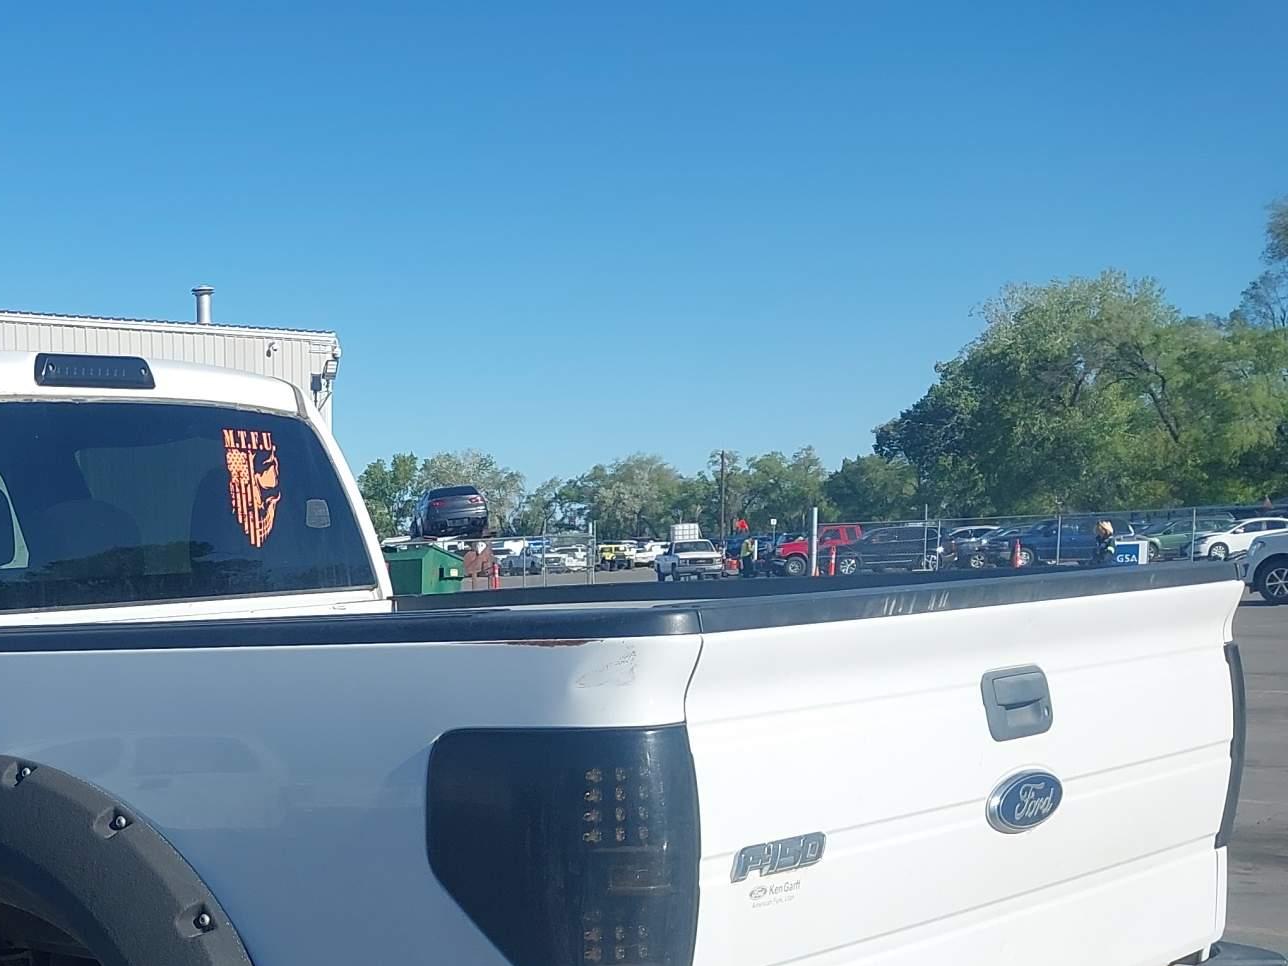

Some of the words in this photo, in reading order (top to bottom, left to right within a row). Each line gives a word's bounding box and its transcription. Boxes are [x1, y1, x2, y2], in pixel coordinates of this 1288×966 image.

[222, 429, 276, 451] M.T.F.U.
[1116, 553, 1138, 563] GSA
[1014, 782, 1055, 821] Ford
